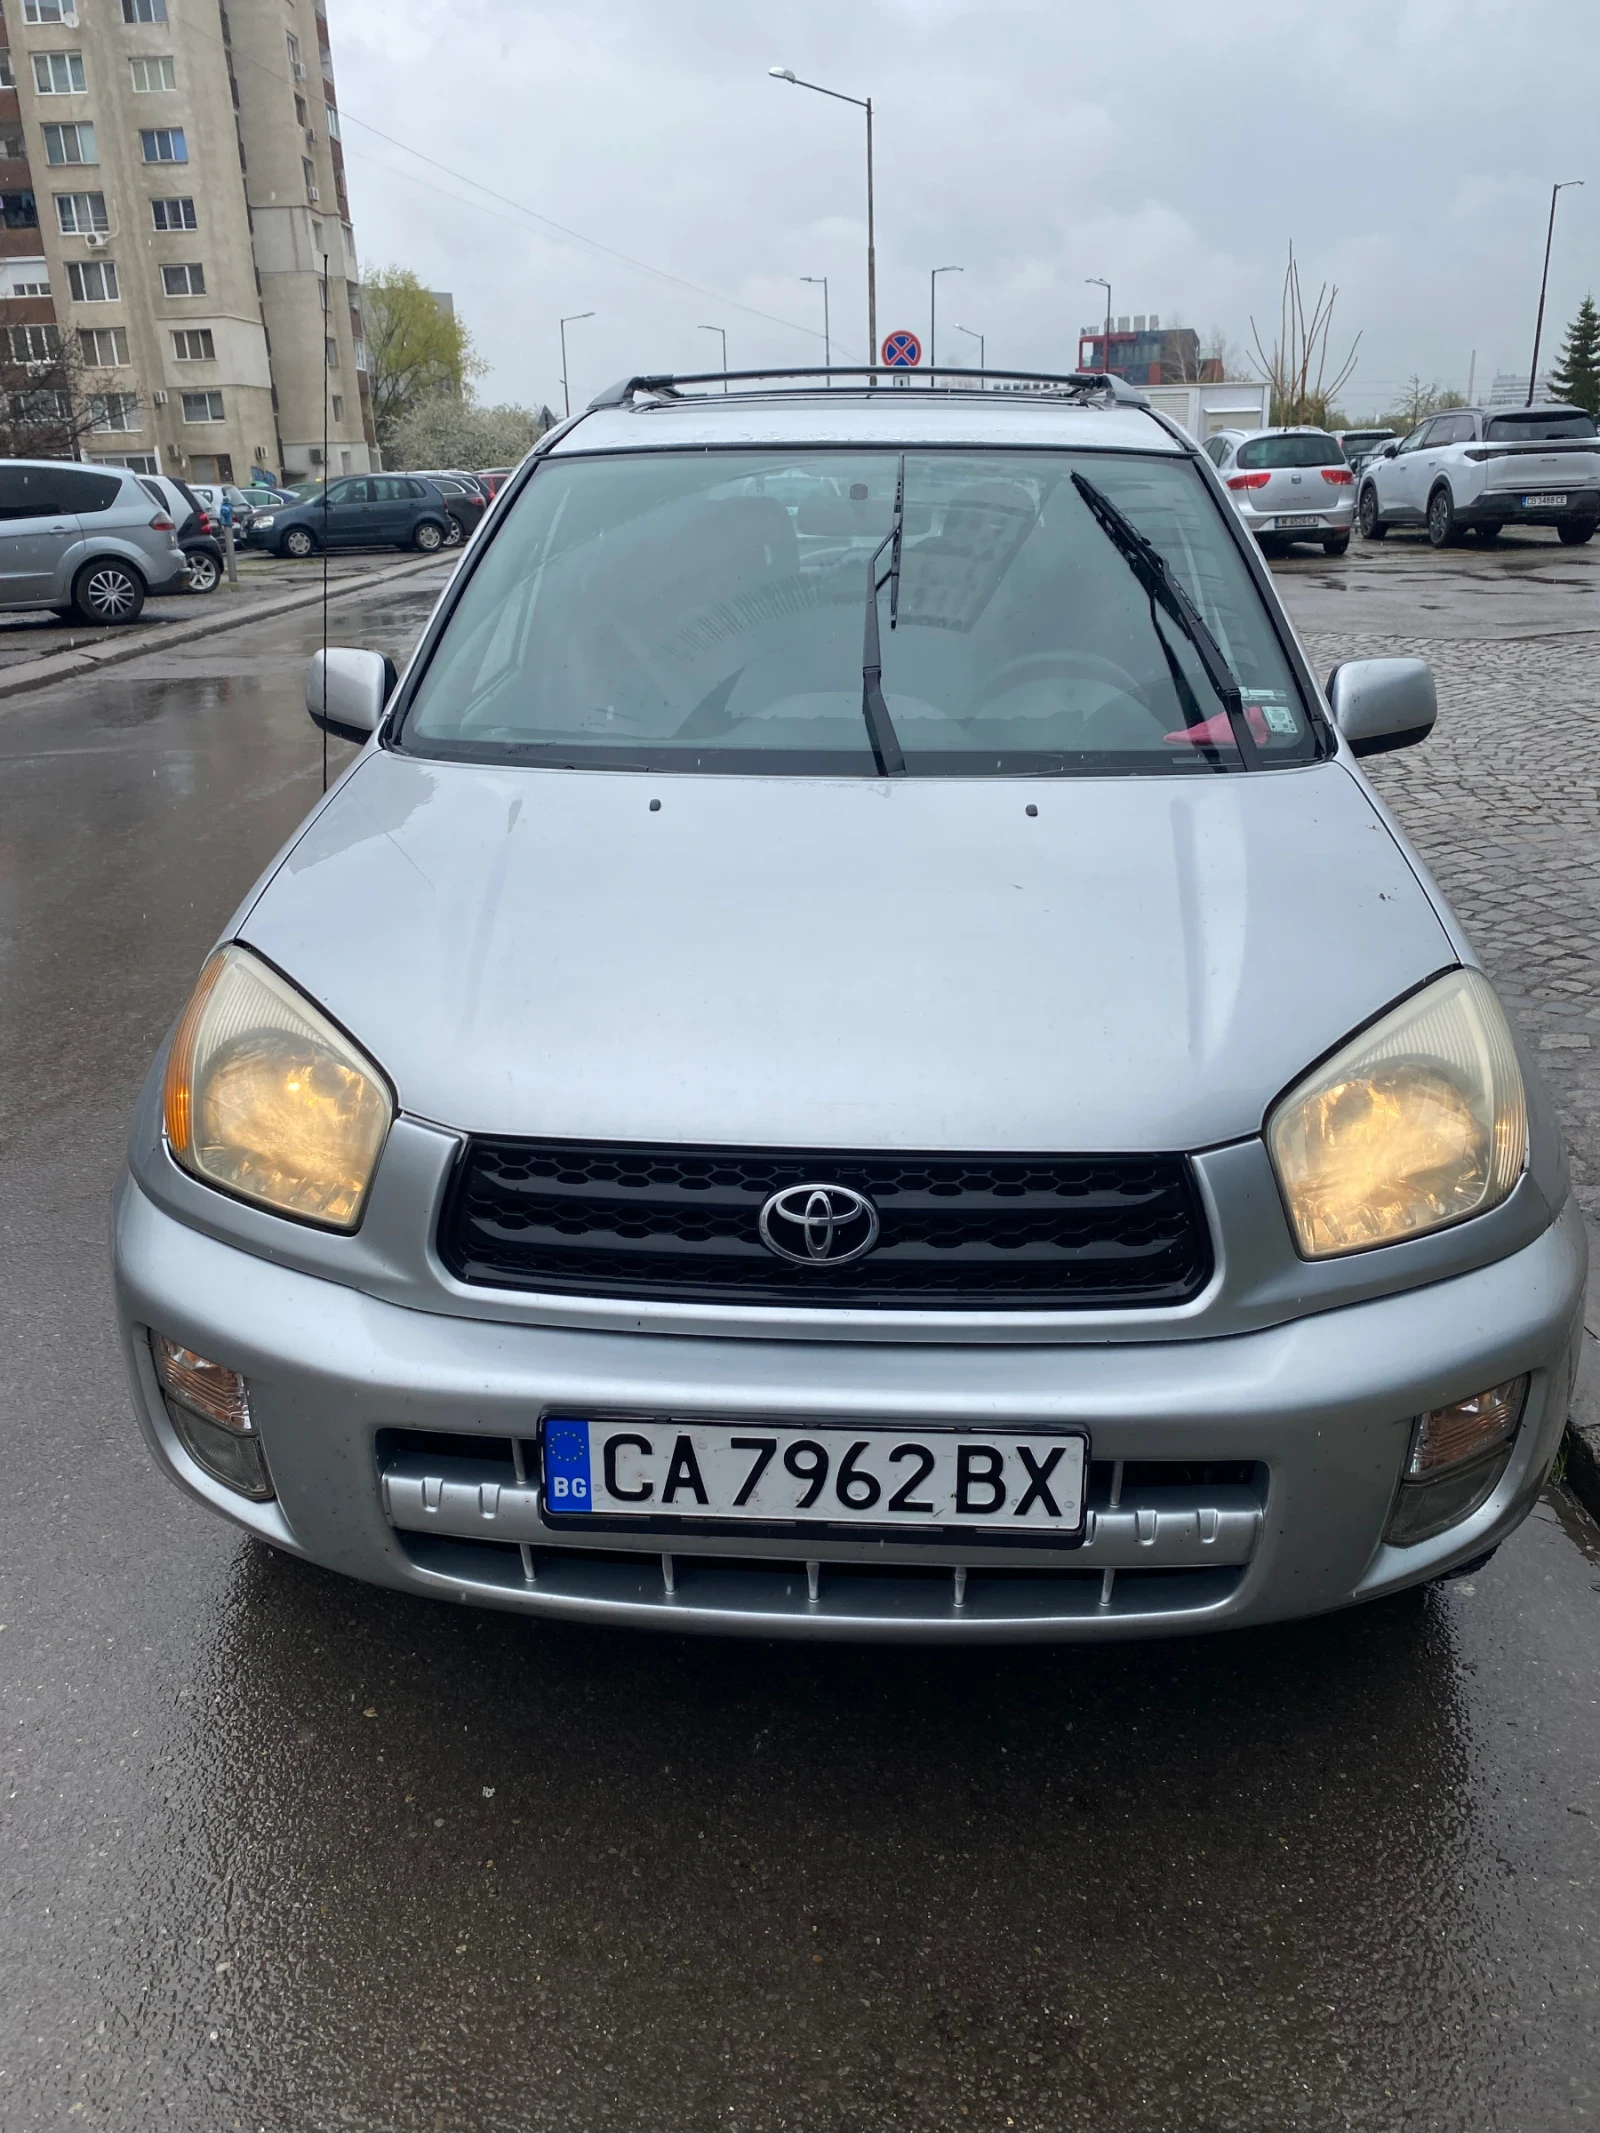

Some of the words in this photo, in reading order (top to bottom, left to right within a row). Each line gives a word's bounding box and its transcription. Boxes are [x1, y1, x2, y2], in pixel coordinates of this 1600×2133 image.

[553, 1476, 587, 1498] BG
[602, 1431, 711, 1506] CA
[729, 1437, 936, 1514] 7962
[955, 1444, 1068, 1518] BX
